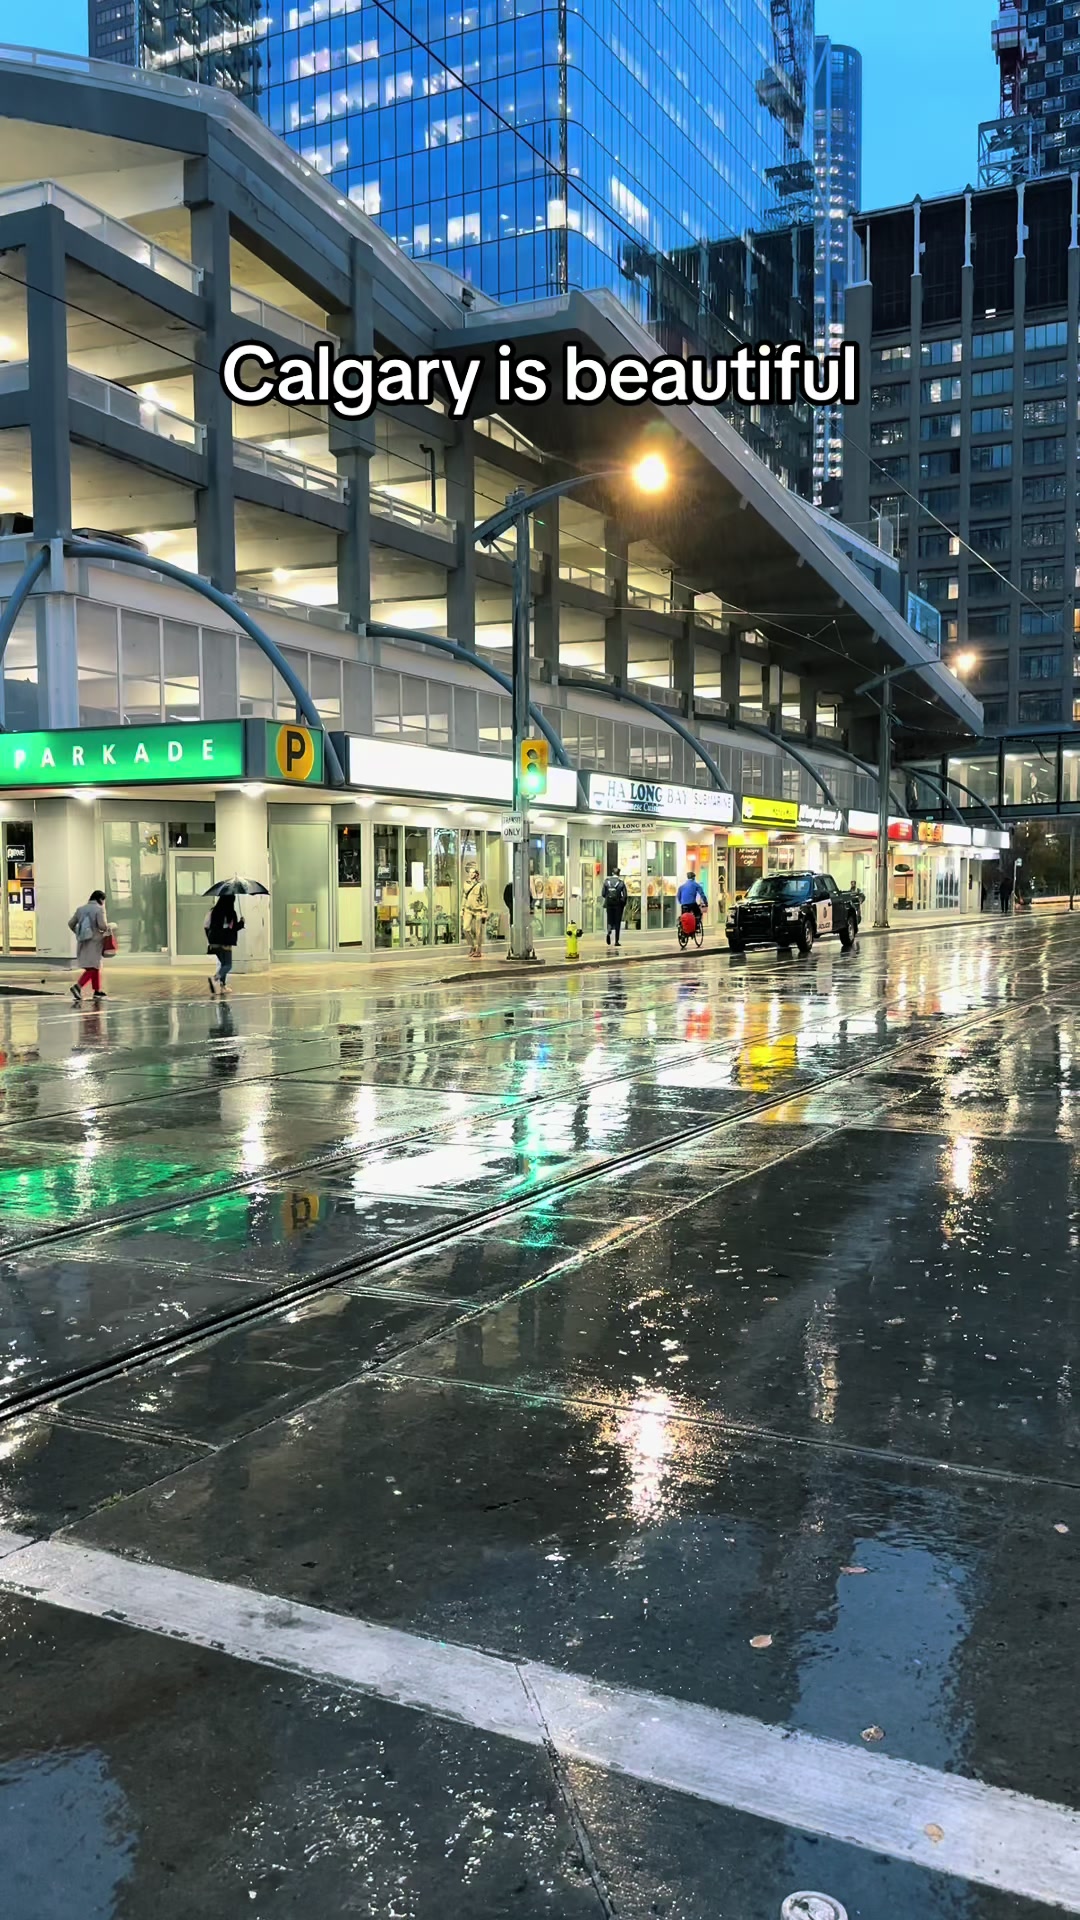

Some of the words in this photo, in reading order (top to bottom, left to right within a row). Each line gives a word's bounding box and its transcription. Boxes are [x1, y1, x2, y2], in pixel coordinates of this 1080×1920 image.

[15, 739, 214, 769] PARKADE
[287, 731, 305, 771] P
[607, 780, 626, 799] HA
[630, 782, 662, 802] LONG
[667, 788, 689, 805] BAY
[504, 828, 521, 836] ONLY
